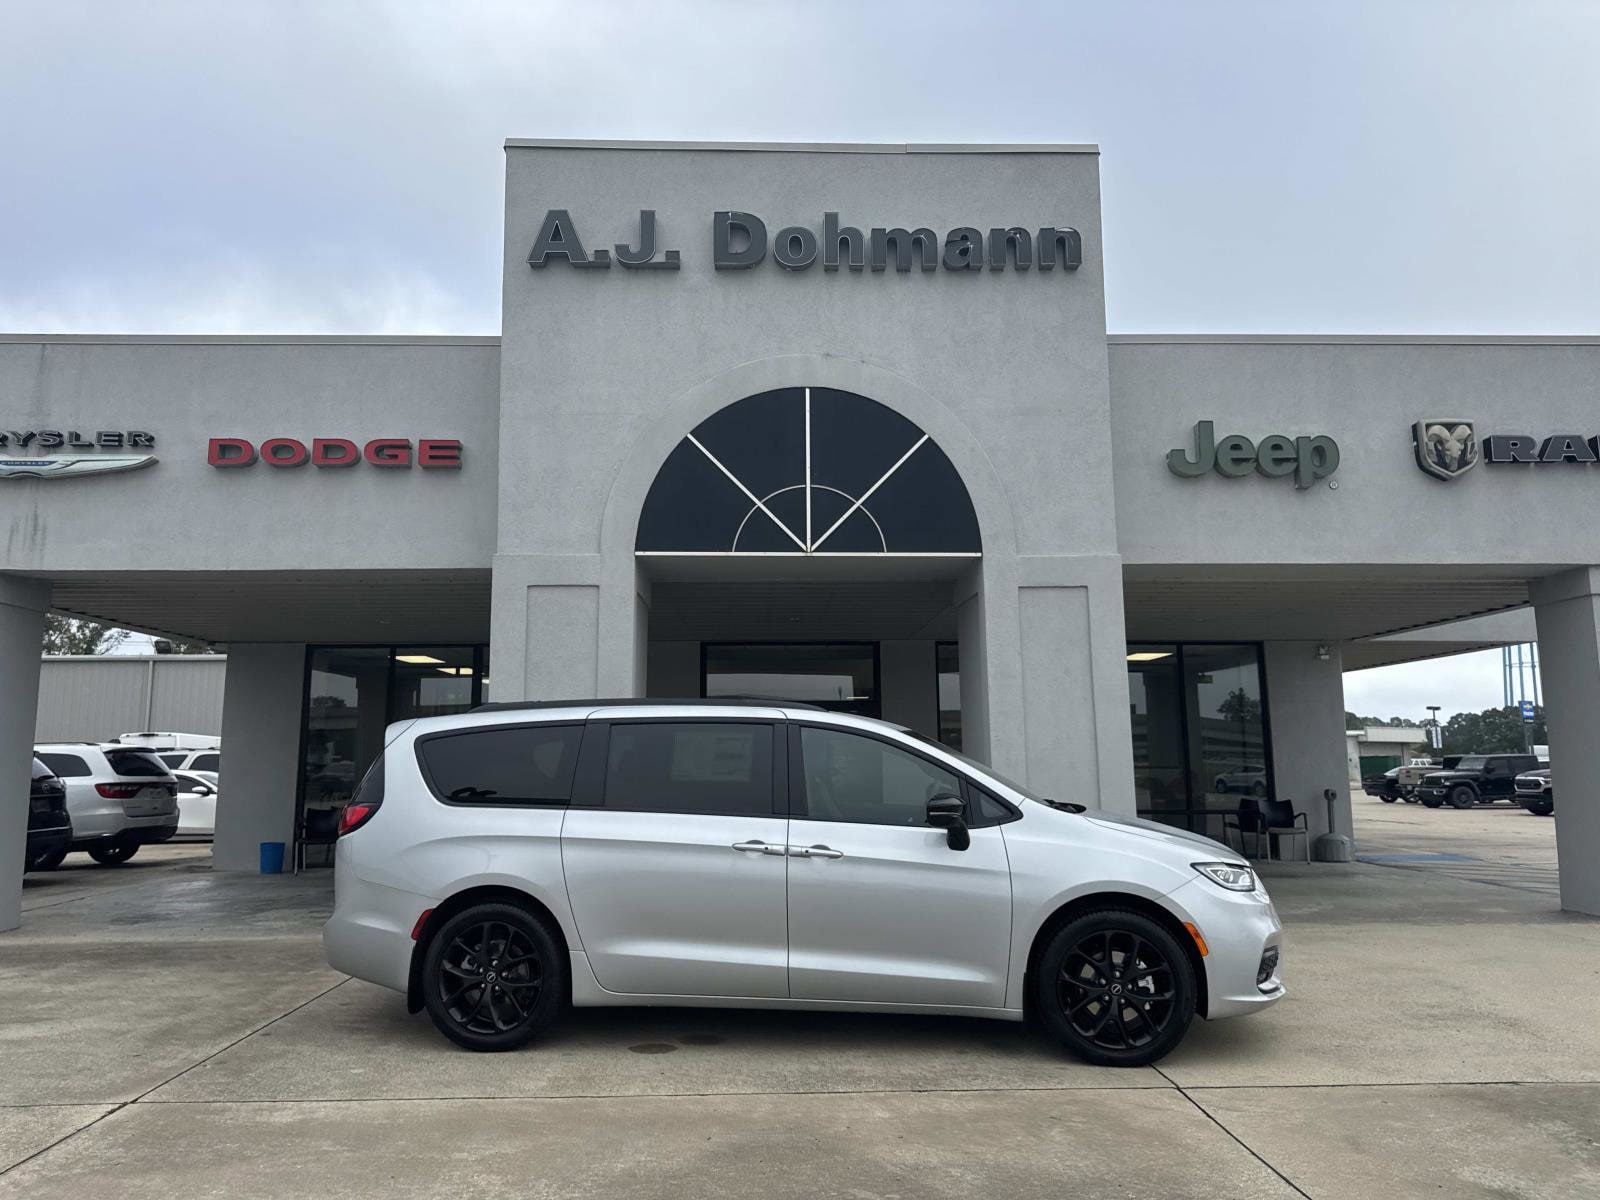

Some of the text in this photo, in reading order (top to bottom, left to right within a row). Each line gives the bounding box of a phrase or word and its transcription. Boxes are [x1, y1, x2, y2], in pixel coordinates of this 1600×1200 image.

[526, 208, 1083, 273] A.J. Dohmann
[206, 437, 464, 471] DODGE
[1166, 420, 1341, 490] Jeep
